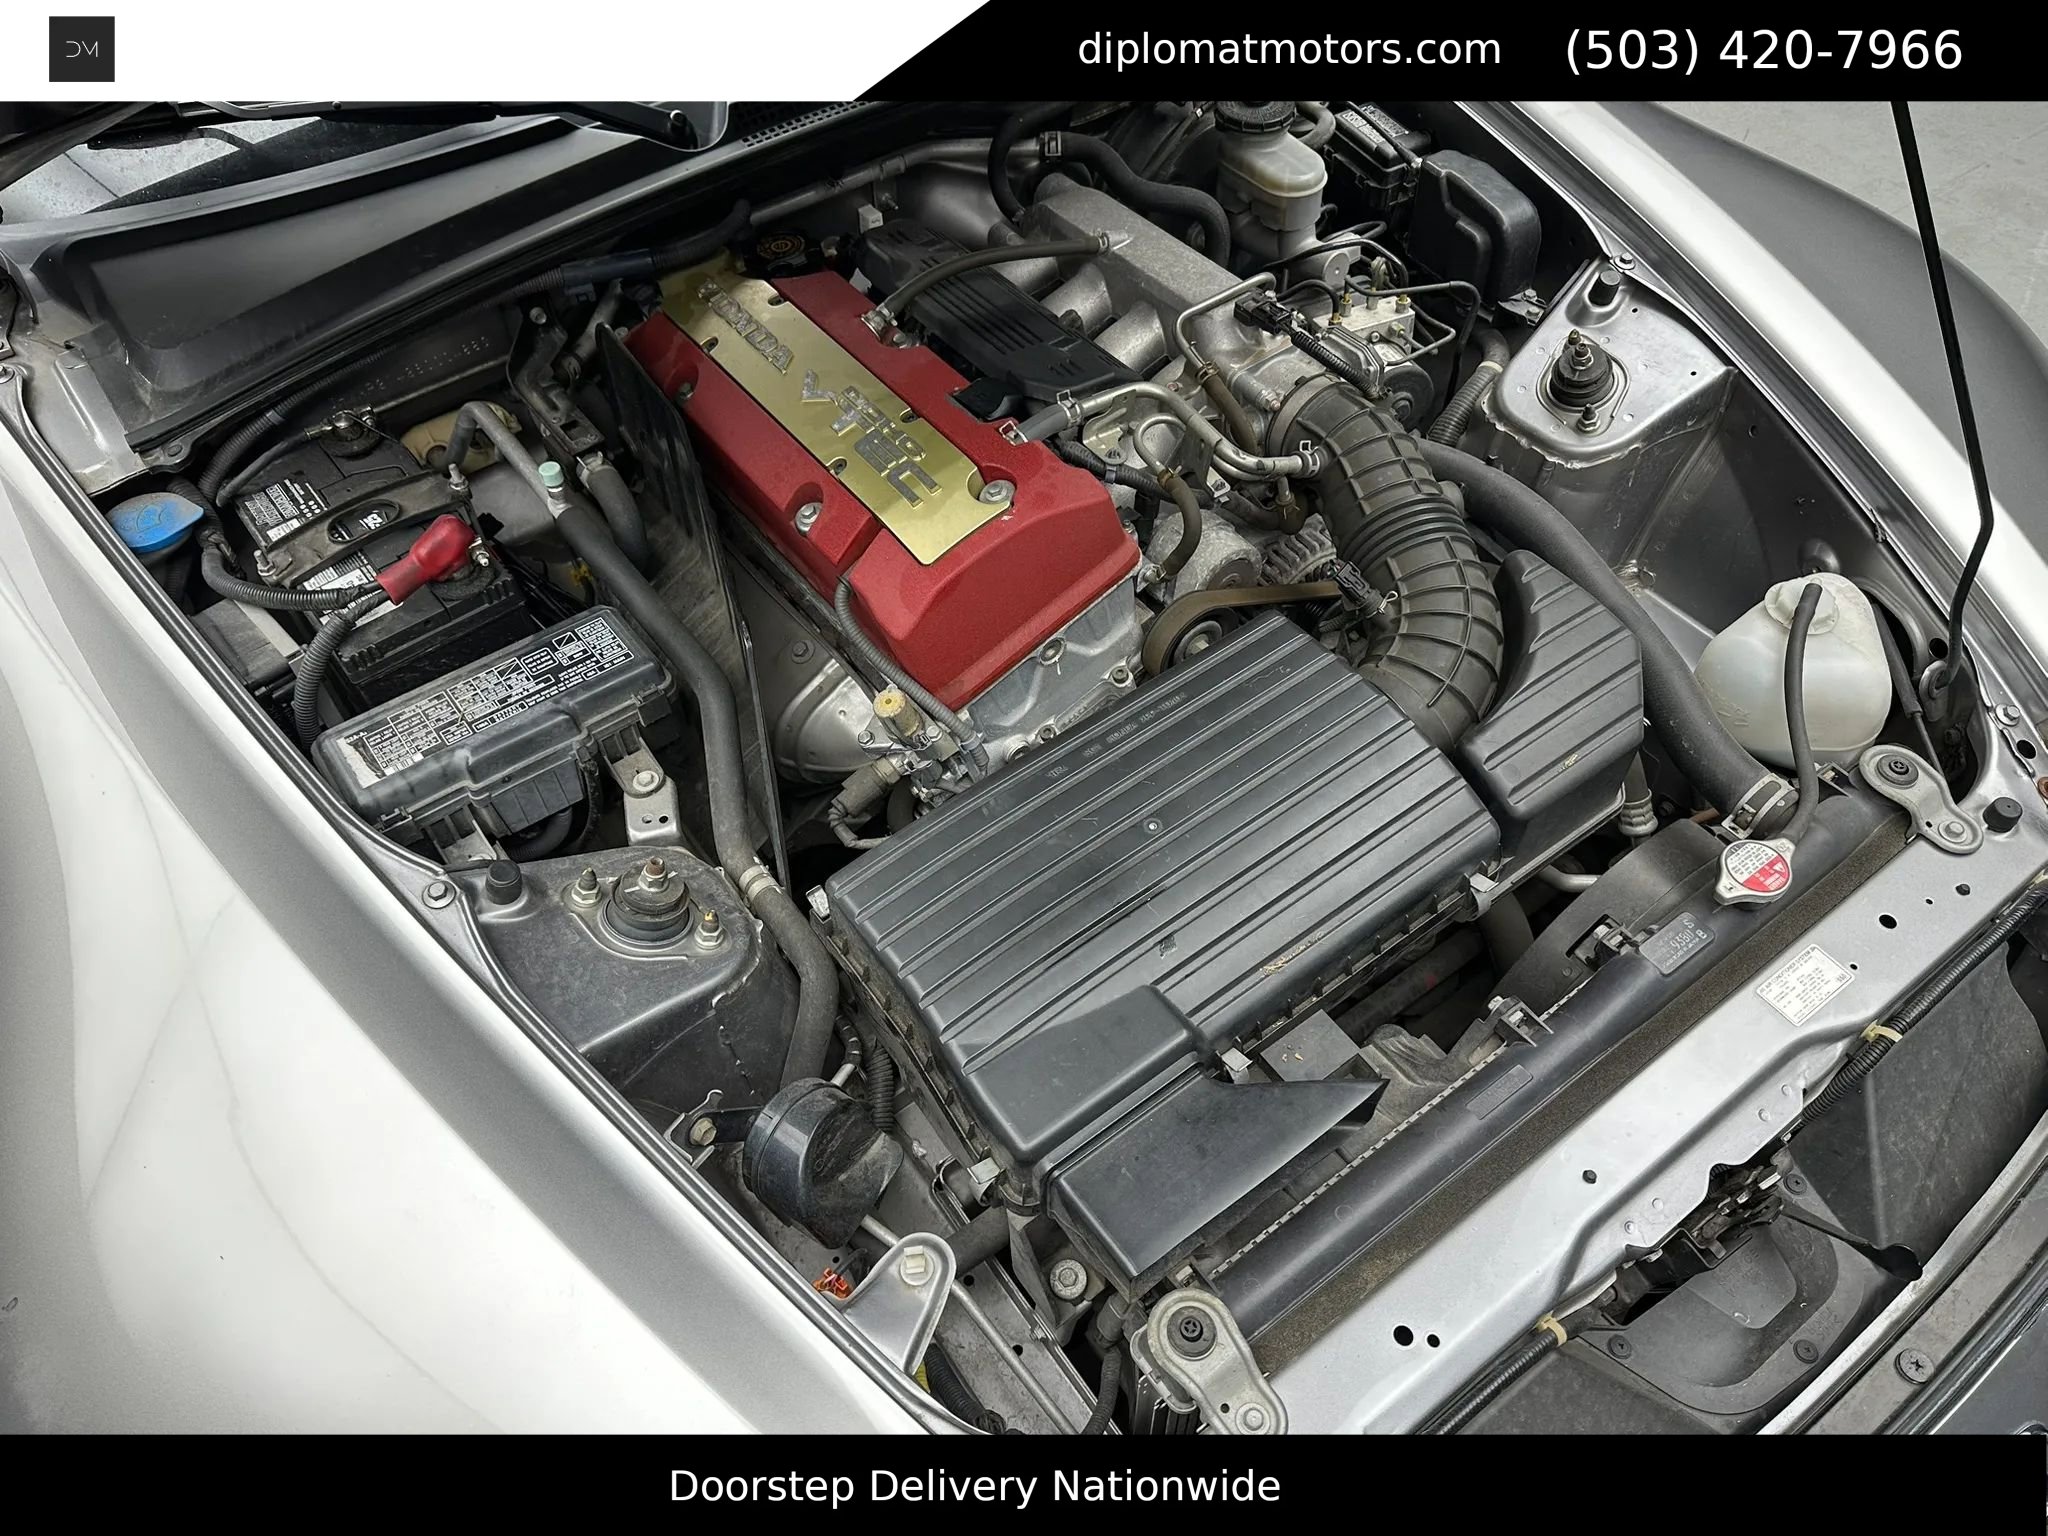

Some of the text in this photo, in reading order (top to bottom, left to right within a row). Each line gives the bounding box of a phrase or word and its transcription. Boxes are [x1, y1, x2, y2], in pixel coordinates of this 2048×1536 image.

[698, 279, 794, 374] HONDA
[802, 368, 942, 508] VTEC
[844, 386, 927, 461] DOHC
